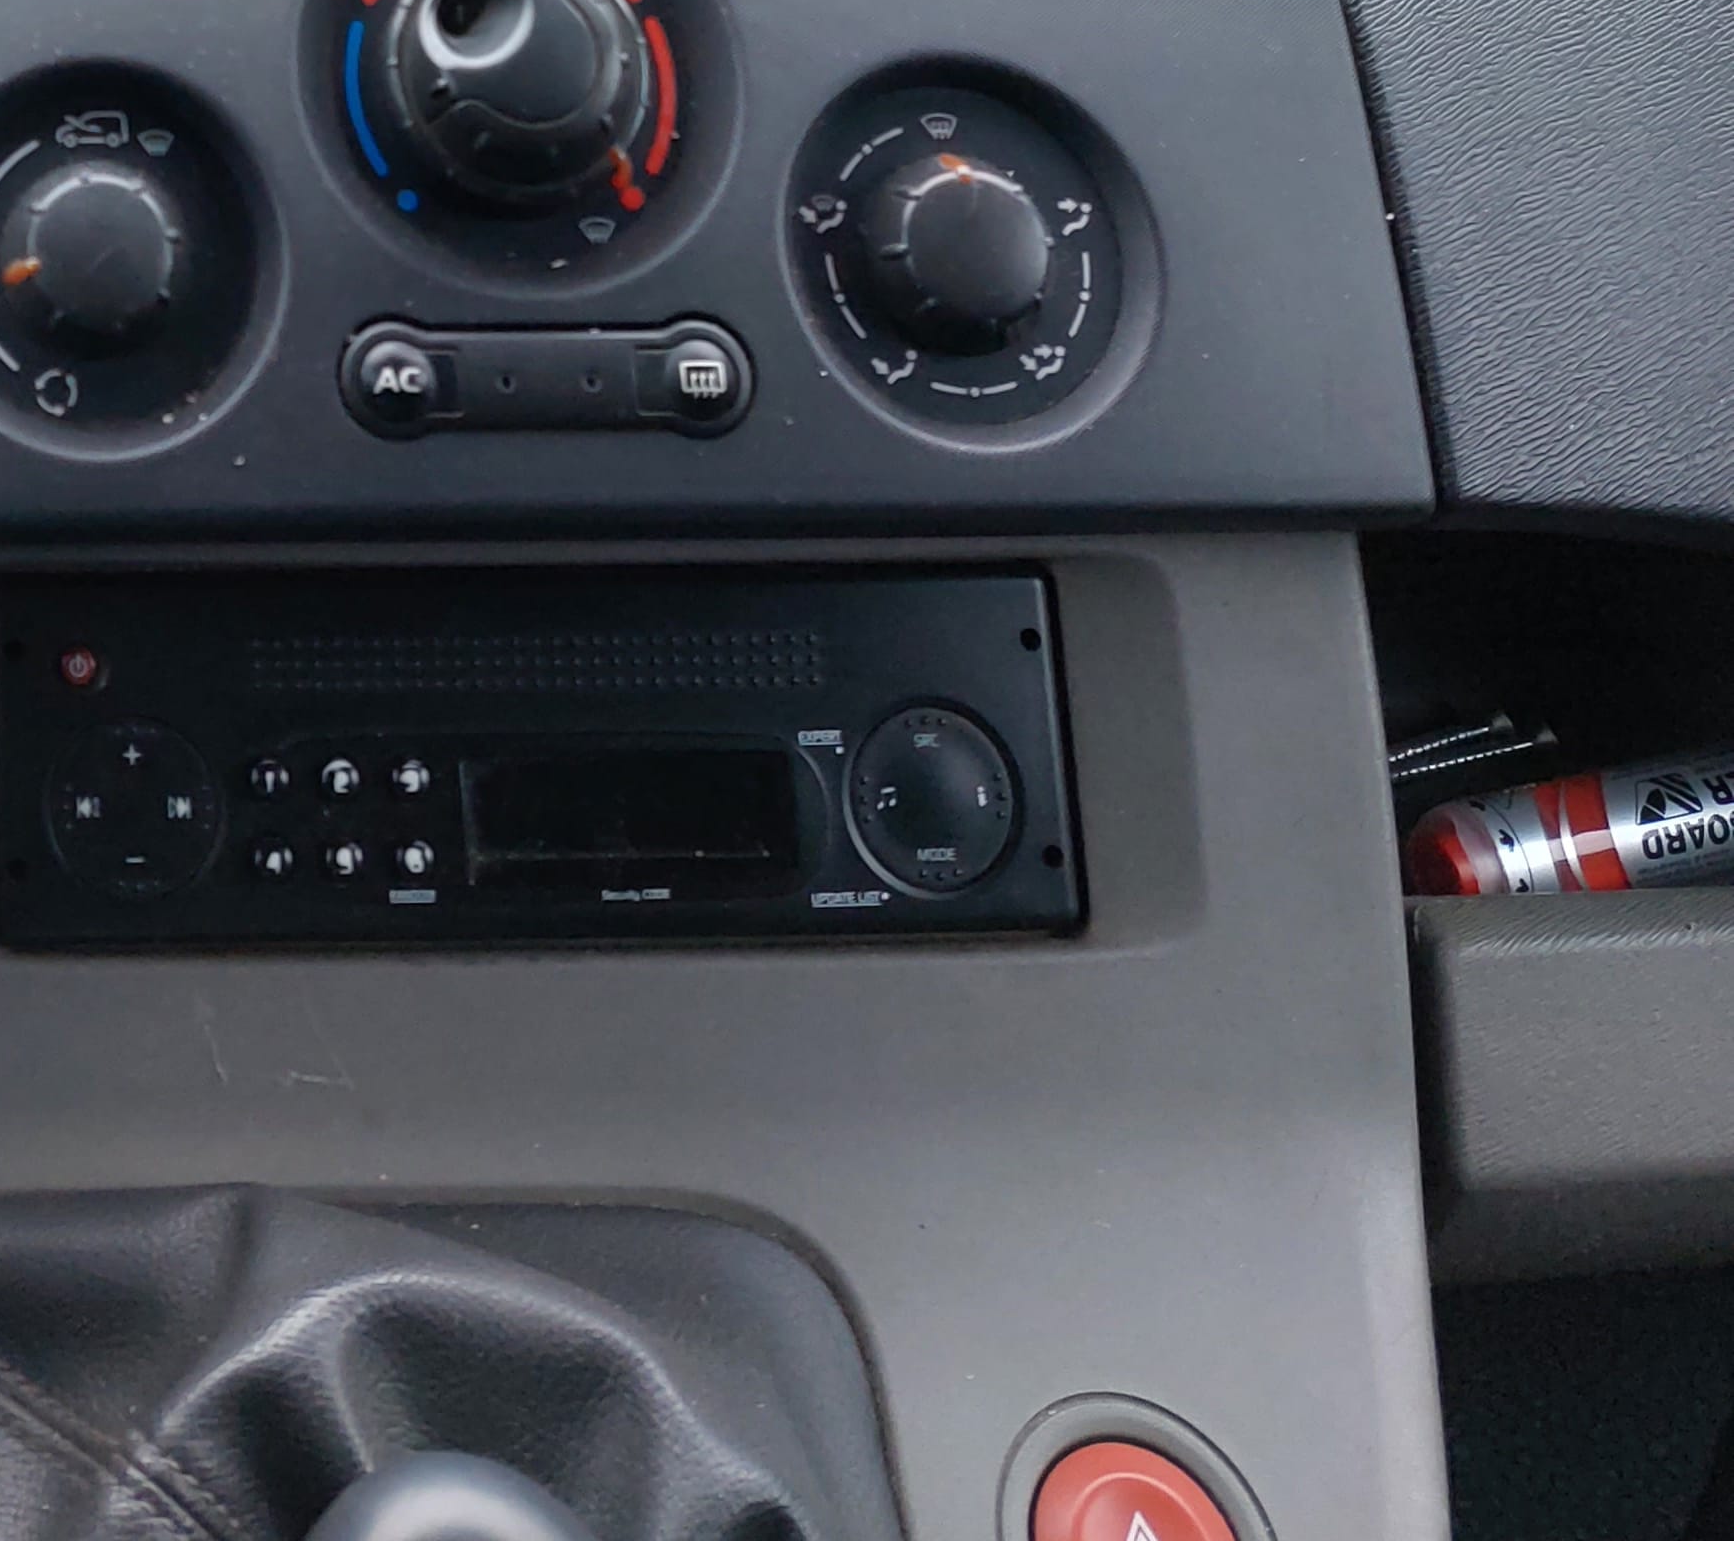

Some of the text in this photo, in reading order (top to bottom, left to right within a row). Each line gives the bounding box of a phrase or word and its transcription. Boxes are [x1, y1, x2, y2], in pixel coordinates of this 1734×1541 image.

[373, 366, 424, 395] AC
[917, 847, 957, 861] MODE
[811, 891, 882, 908] UPDATE LIST
